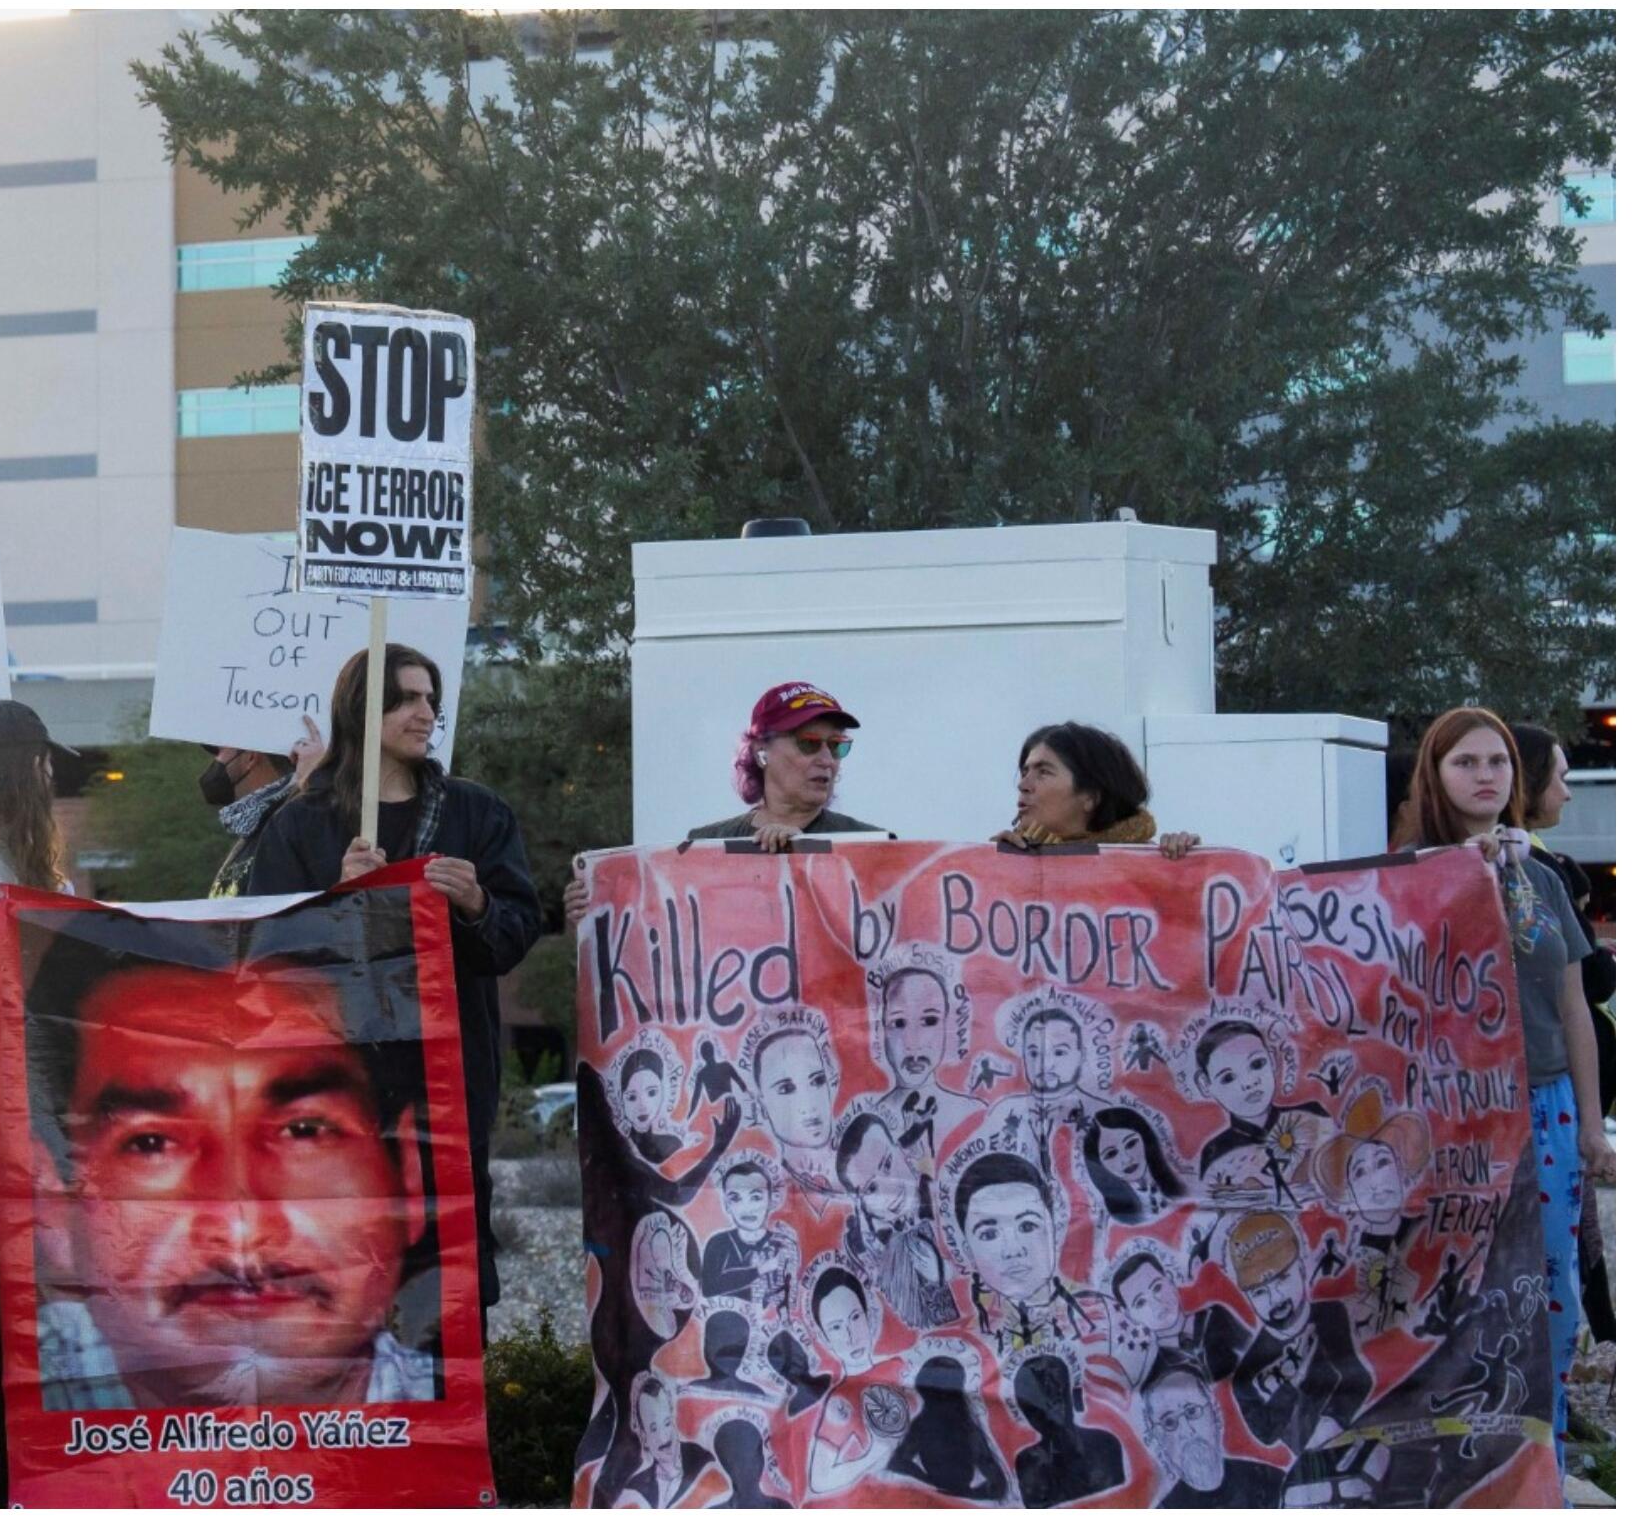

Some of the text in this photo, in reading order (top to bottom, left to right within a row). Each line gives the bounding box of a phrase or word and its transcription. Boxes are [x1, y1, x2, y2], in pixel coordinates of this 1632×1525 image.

[309, 321, 467, 442] STOP
[306, 461, 463, 521] ICE TERROR
[306, 519, 463, 561] NOW!
[253, 607, 342, 639] OUT
[221, 667, 319, 713] Tucson
[595, 884, 799, 1043] Killed
[851, 879, 897, 960] by
[943, 873, 1171, 990] BORDER
[1428, 1192, 1503, 1243] TERIZA
[67, 1412, 409, 1454] José Alfredo Yáñez
[169, 1468, 313, 1506] 40 años
